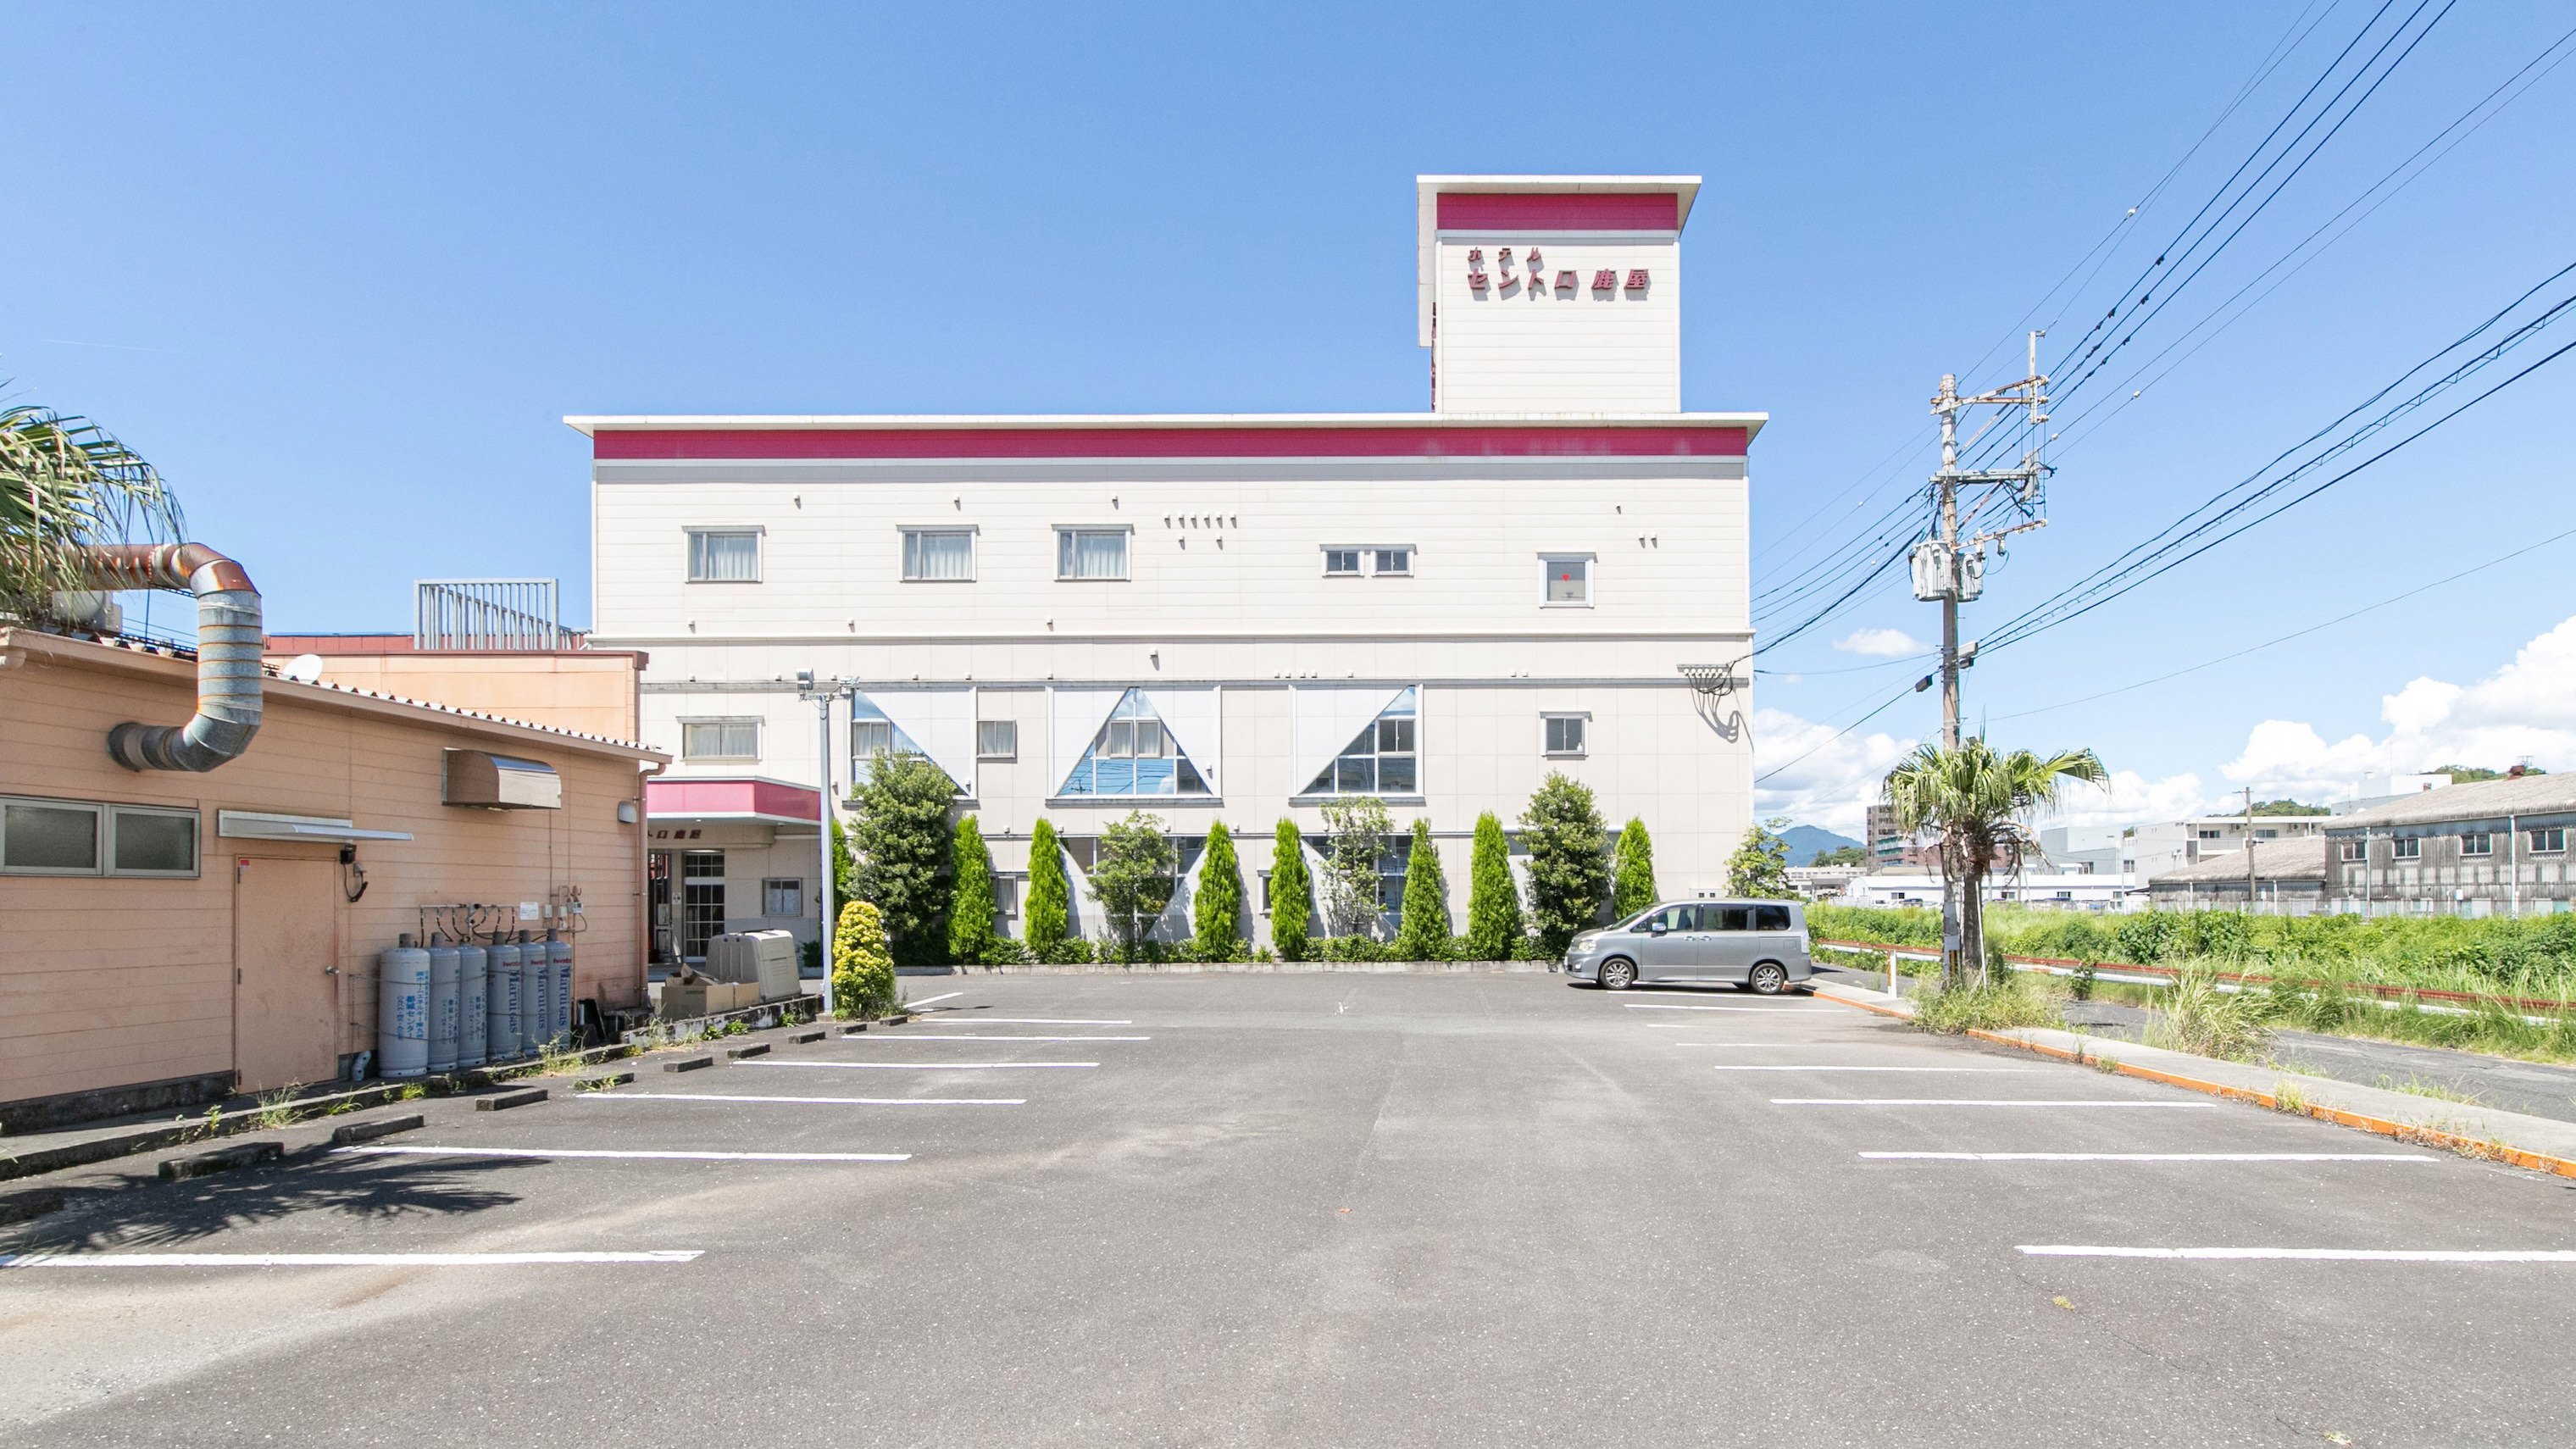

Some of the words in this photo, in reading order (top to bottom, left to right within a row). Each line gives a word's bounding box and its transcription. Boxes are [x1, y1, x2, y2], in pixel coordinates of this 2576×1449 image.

[1468, 247, 1542, 262] ホテル
[1468, 269, 1649, 290] セントロ鹿屋
